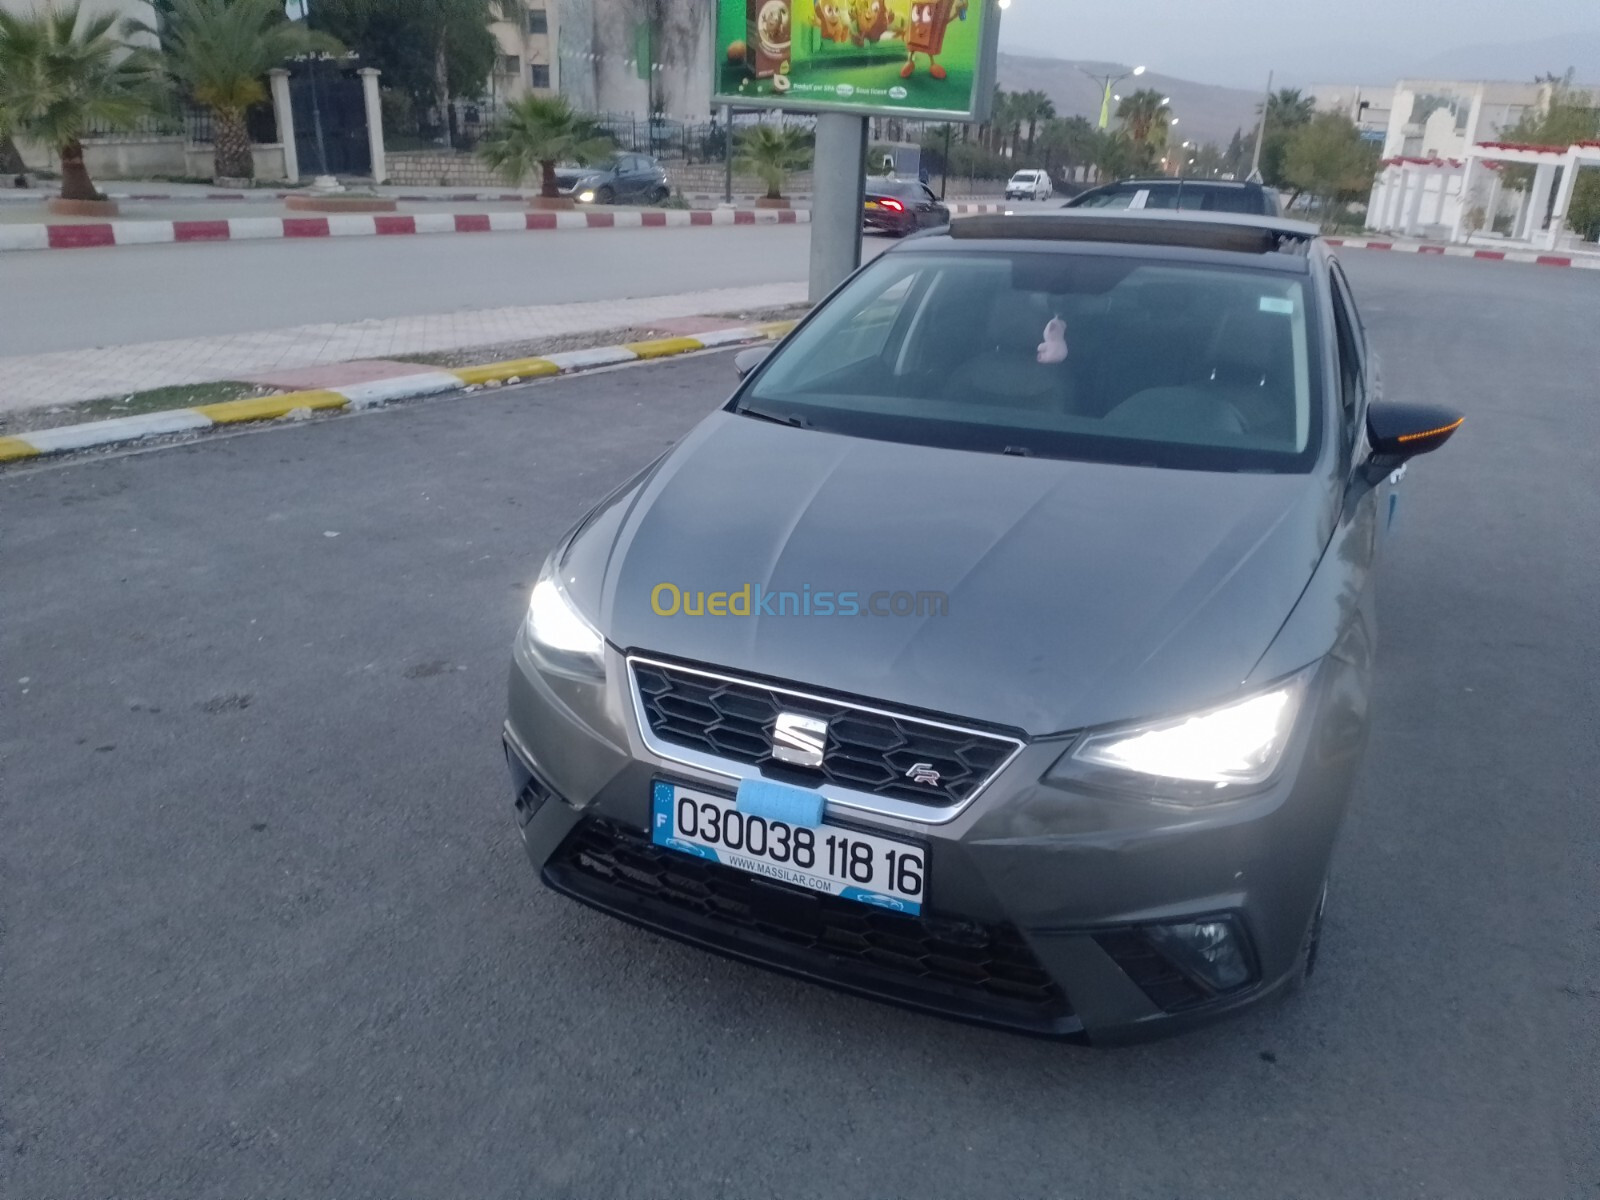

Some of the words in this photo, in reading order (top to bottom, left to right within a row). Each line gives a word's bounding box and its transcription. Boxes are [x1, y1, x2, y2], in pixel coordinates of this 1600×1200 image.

[656, 812, 668, 828] F
[677, 797, 816, 869] 030038
[825, 835, 874, 884] 118
[885, 849, 923, 896] 16
[729, 855, 832, 892] WWW.MASSILAR.COM
